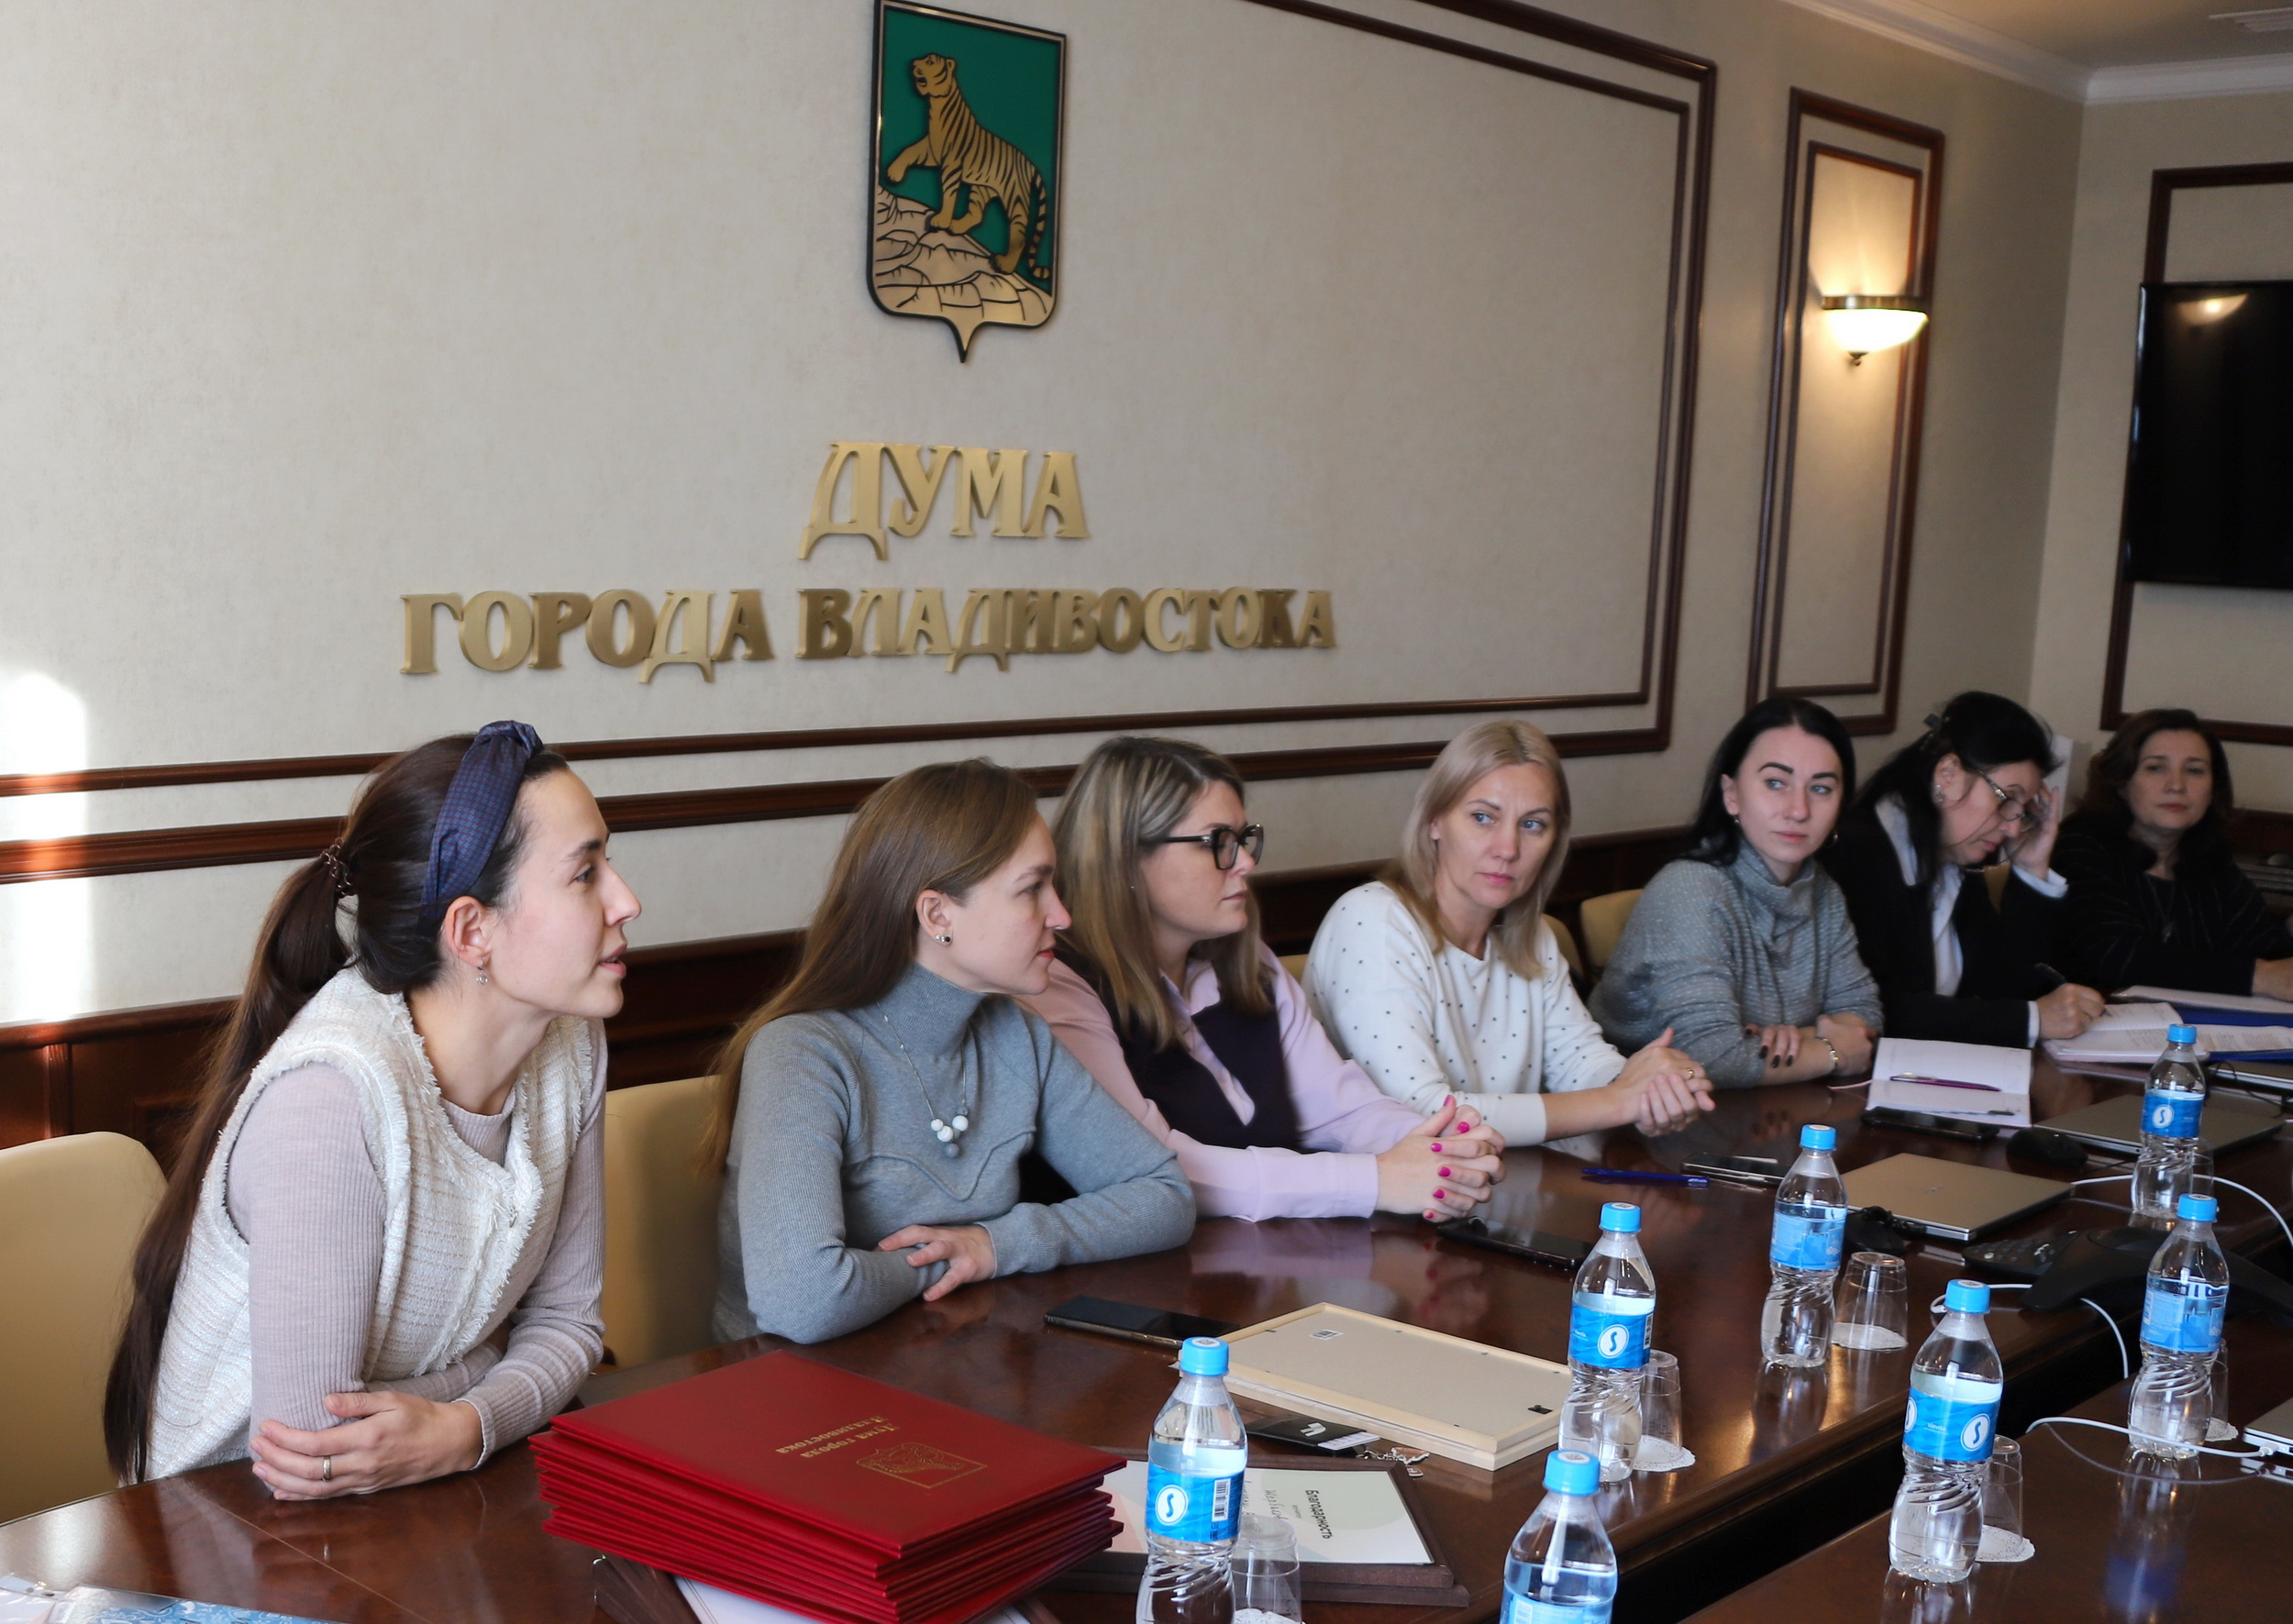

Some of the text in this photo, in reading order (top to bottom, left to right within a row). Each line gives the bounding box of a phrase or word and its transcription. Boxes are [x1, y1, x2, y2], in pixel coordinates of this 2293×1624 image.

[797, 441, 1091, 561] ДУМА
[399, 587, 1338, 684] ГОРОДА ВЛАДИВОСТОКА
[1304, 1489, 1334, 1540] Благодарность
